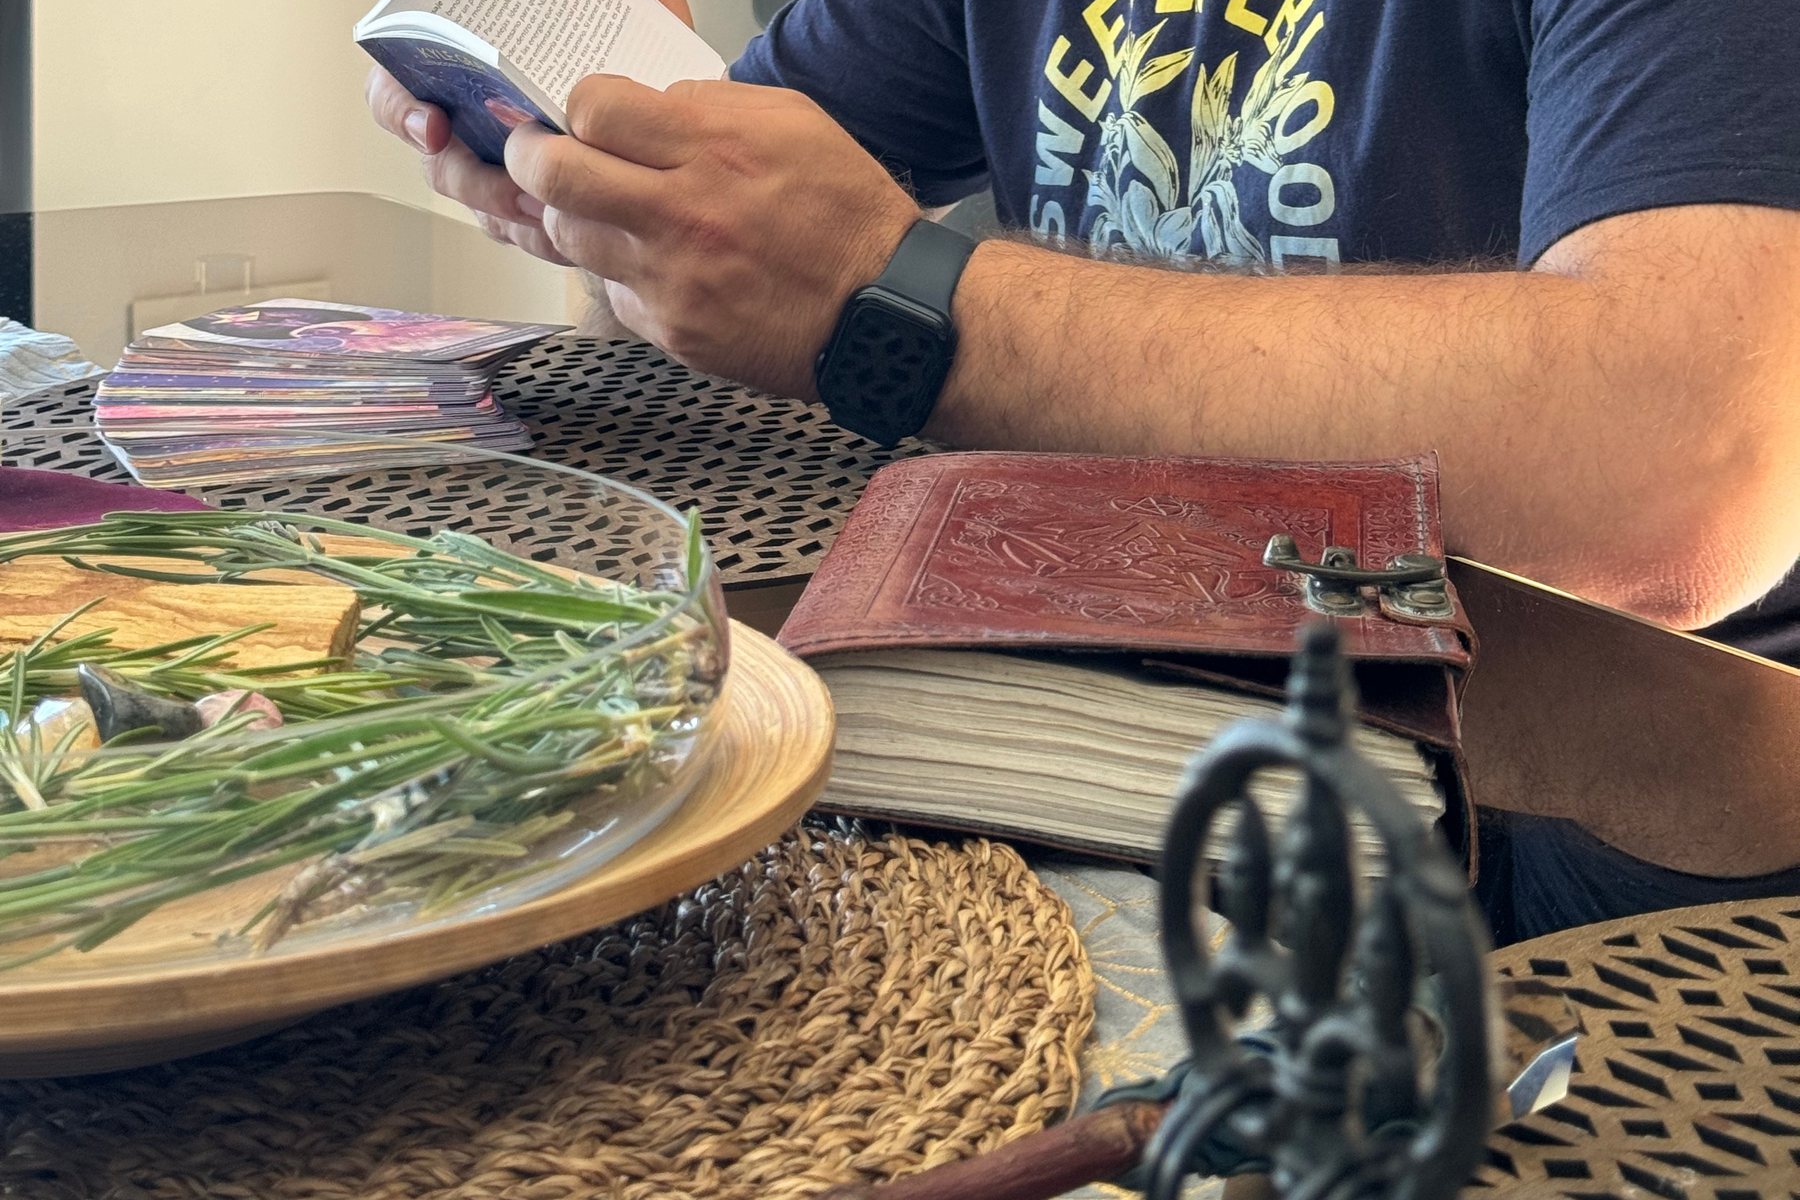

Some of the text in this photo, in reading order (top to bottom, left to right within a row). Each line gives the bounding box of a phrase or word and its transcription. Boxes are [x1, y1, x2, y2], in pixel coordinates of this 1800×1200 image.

[460, 3, 470, 14] un
[494, 18, 512, 39] viejas
[507, 0, 522, 19] ideas
[571, 20, 580, 32] de
[575, 10, 585, 23] luz
[482, 19, 497, 36] Para
[498, 19, 522, 52] necesario
[519, 5, 532, 23] para
[514, 22, 532, 46] dentro
[528, 13, 538, 25] de
[514, 53, 524, 65] de
[520, 44, 531, 56] las
[527, 17, 548, 47] energías
[544, 6, 555, 21] que
[523, 56, 536, 72] que
[531, 21, 557, 58] enfrentarte
[555, 7, 564, 19] las
[533, 63, 542, 73] tu
[538, 39, 558, 66] historia
[558, 7, 575, 35] esencial
[562, 30, 575, 48] seres
[594, 4, 632, 72] algo extremadamente
[545, 76, 559, 94] para
[555, 58, 570, 79] guiar
[565, 51, 574, 61] el
[587, 3, 600, 23] tienes
[554, 47, 565, 59] los
[559, 66, 577, 89] miedo
[574, 57, 583, 68] en
[579, 41, 592, 58] este
[591, 38, 604, 56] hace
